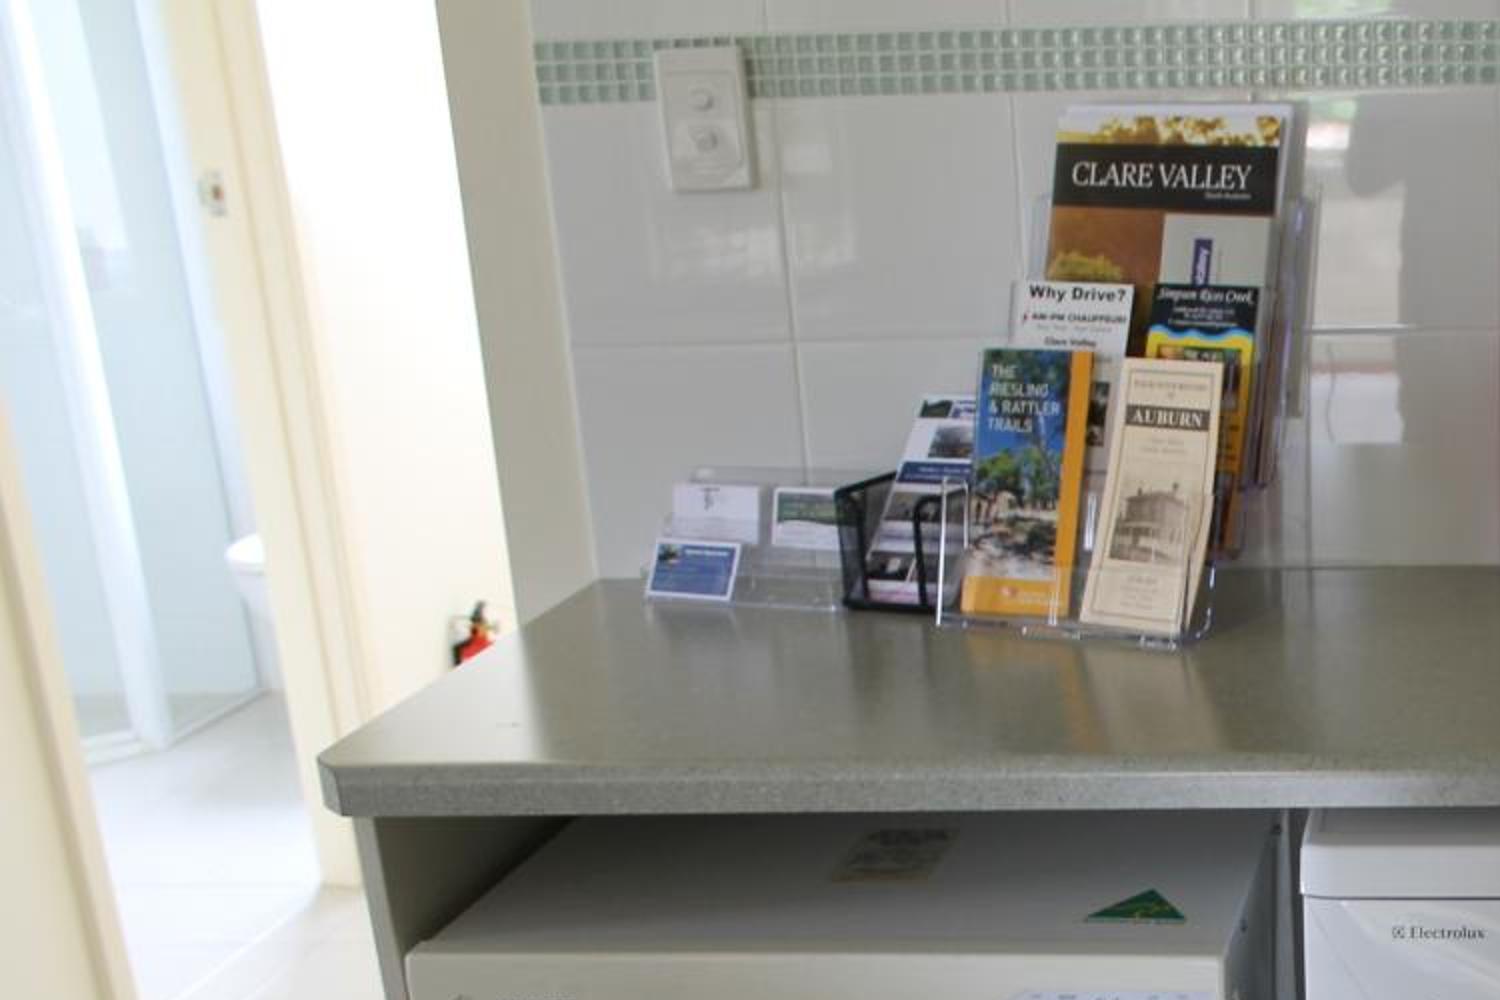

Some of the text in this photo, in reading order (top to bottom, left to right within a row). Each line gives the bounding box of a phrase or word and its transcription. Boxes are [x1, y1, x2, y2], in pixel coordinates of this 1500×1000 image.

[1072, 161, 1251, 190] CLARE VALLEY
[1029, 285, 1126, 302] Why Drive?
[992, 364, 1016, 379] THE
[989, 381, 1049, 397] RIESLING
[1004, 399, 1060, 417] RATTLER
[989, 416, 1032, 432] TRAILS
[1132, 405, 1204, 428] AUBURN
[1410, 926, 1486, 940] Electrolux
